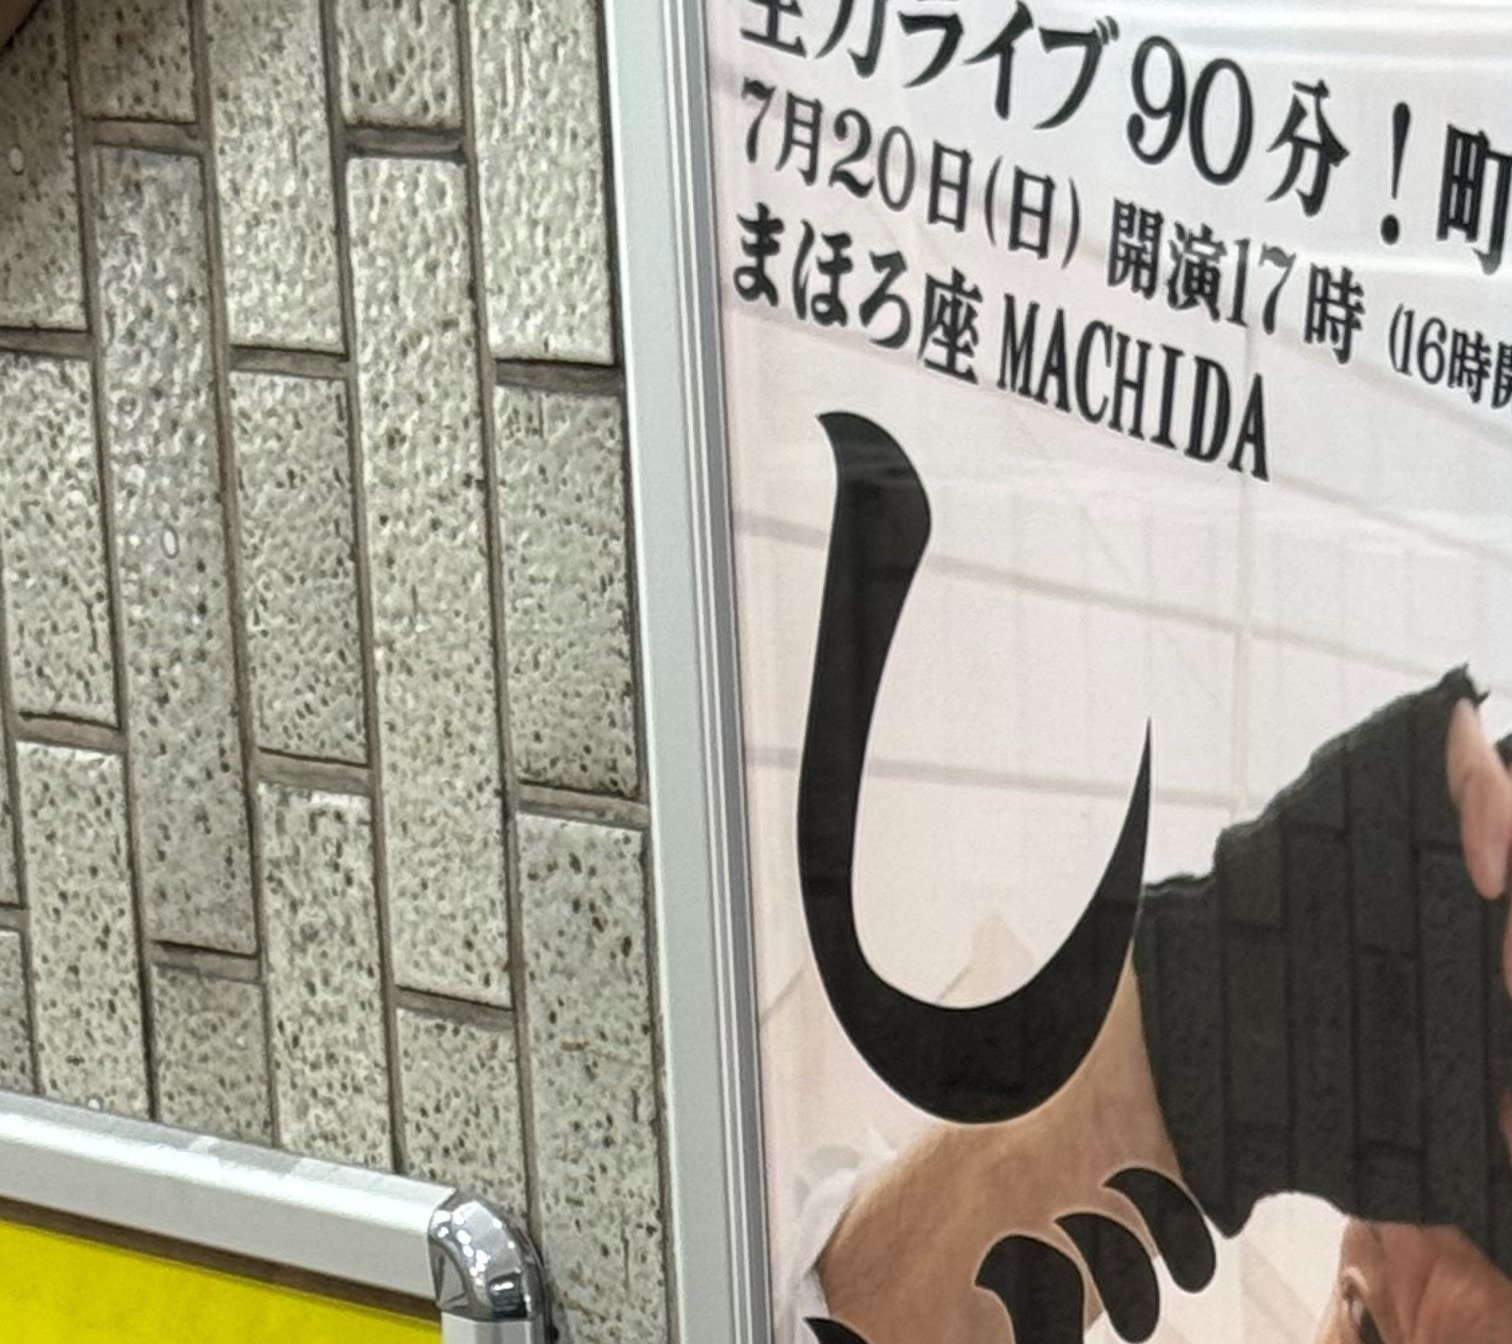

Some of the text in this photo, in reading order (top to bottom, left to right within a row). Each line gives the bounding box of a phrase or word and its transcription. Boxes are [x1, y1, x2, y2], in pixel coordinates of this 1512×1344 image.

[732, 203, 1271, 481] まほろ座 MACHIDA
[1107, 198, 1366, 365] 開演17時
